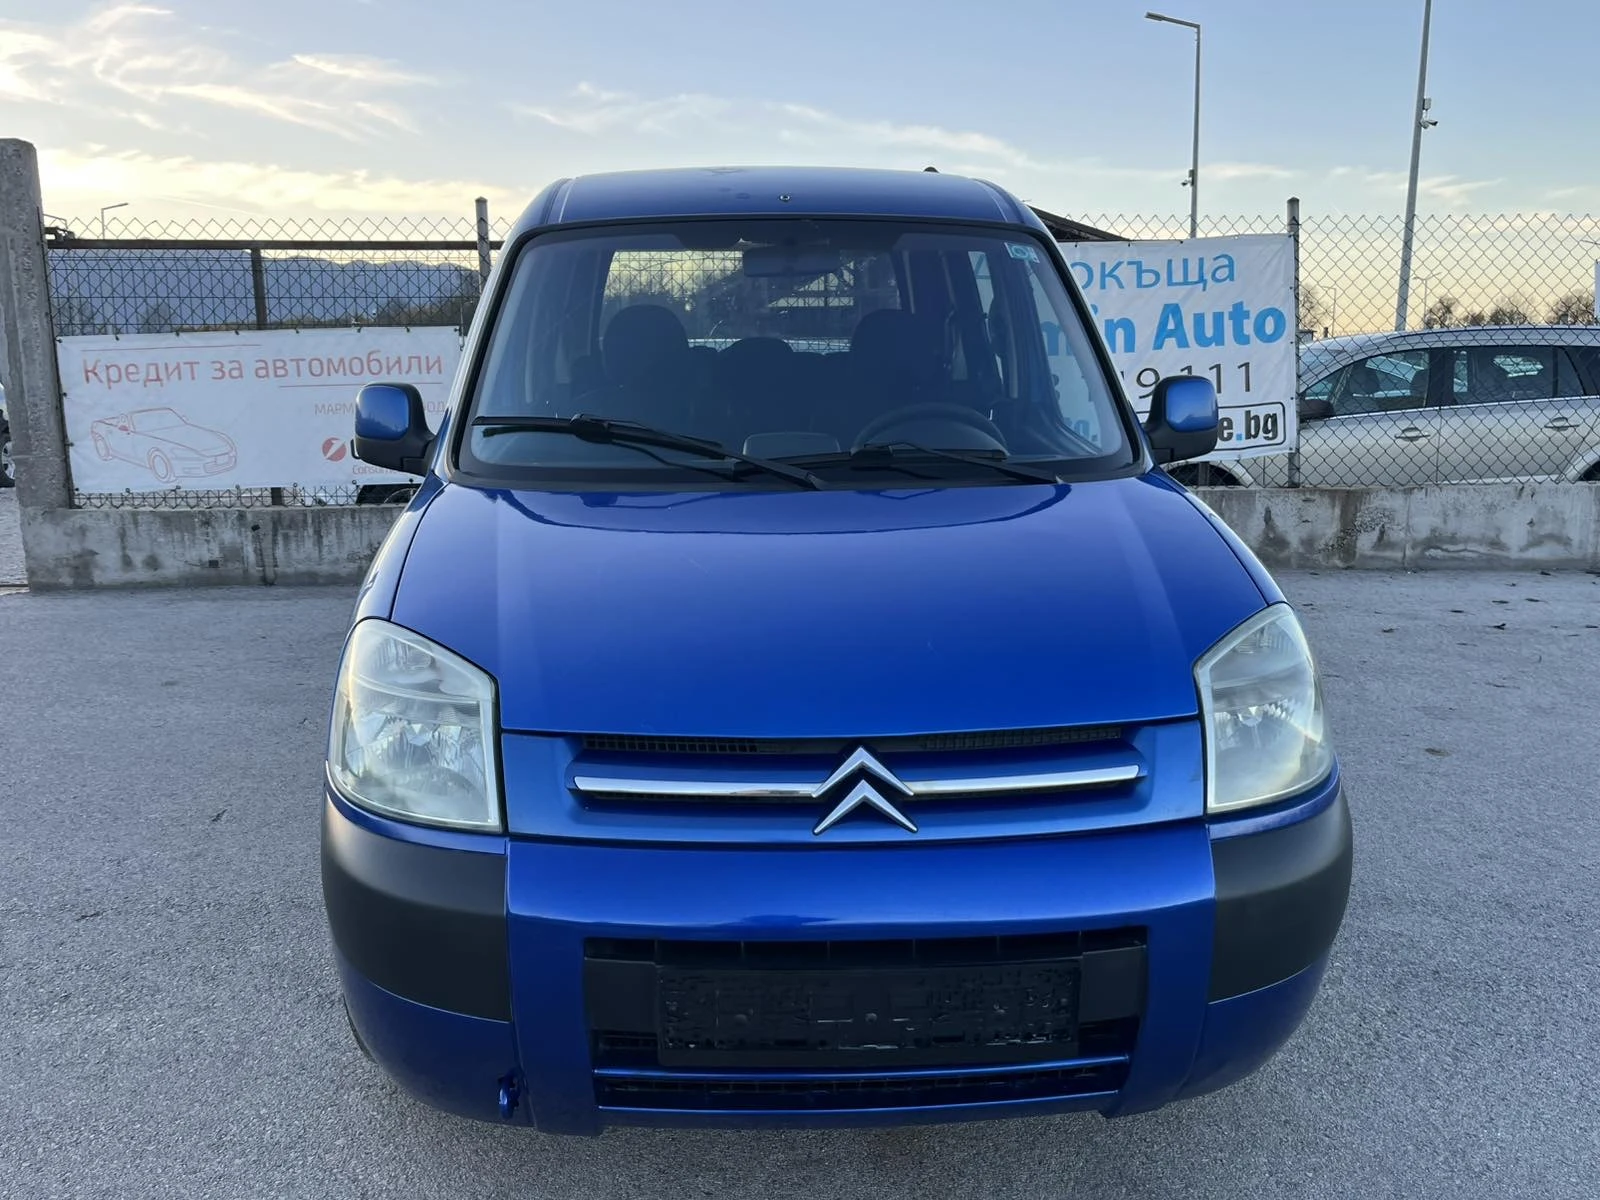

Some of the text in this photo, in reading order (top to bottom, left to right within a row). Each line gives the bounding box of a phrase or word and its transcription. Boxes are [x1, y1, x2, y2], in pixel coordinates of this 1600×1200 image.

[1069, 253, 1236, 292] окъща
[1152, 300, 1287, 351] Auto
[83, 350, 443, 390] Кредит за автомобили
[314, 401, 356, 416] МАРМ
[1217, 410, 1279, 442] e.bg
